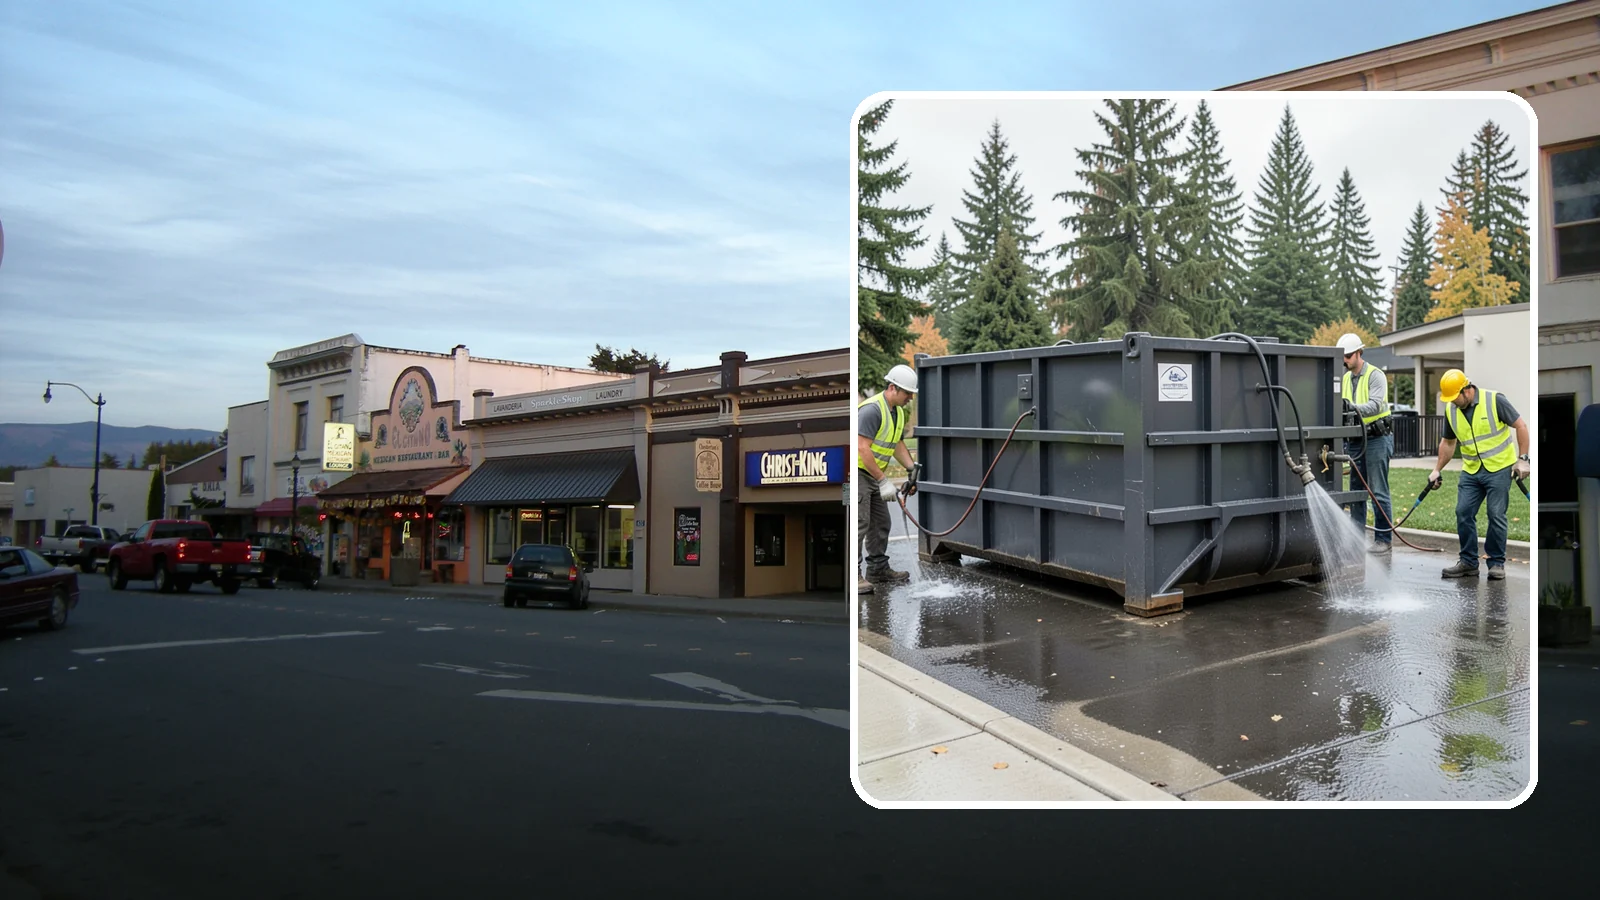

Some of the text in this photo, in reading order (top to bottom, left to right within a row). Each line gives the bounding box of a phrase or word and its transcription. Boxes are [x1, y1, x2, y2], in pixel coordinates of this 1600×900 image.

[530, 394, 582, 409] Sparkle Shop
[595, 389, 625, 400] LAUNDRY
[493, 402, 523, 412] LAVANDERIA
[373, 454, 396, 464] MEXICAN
[397, 451, 434, 462] RESTAURANT
[438, 450, 450, 459] BAR
[761, 450, 827, 478] CHRIST KING
